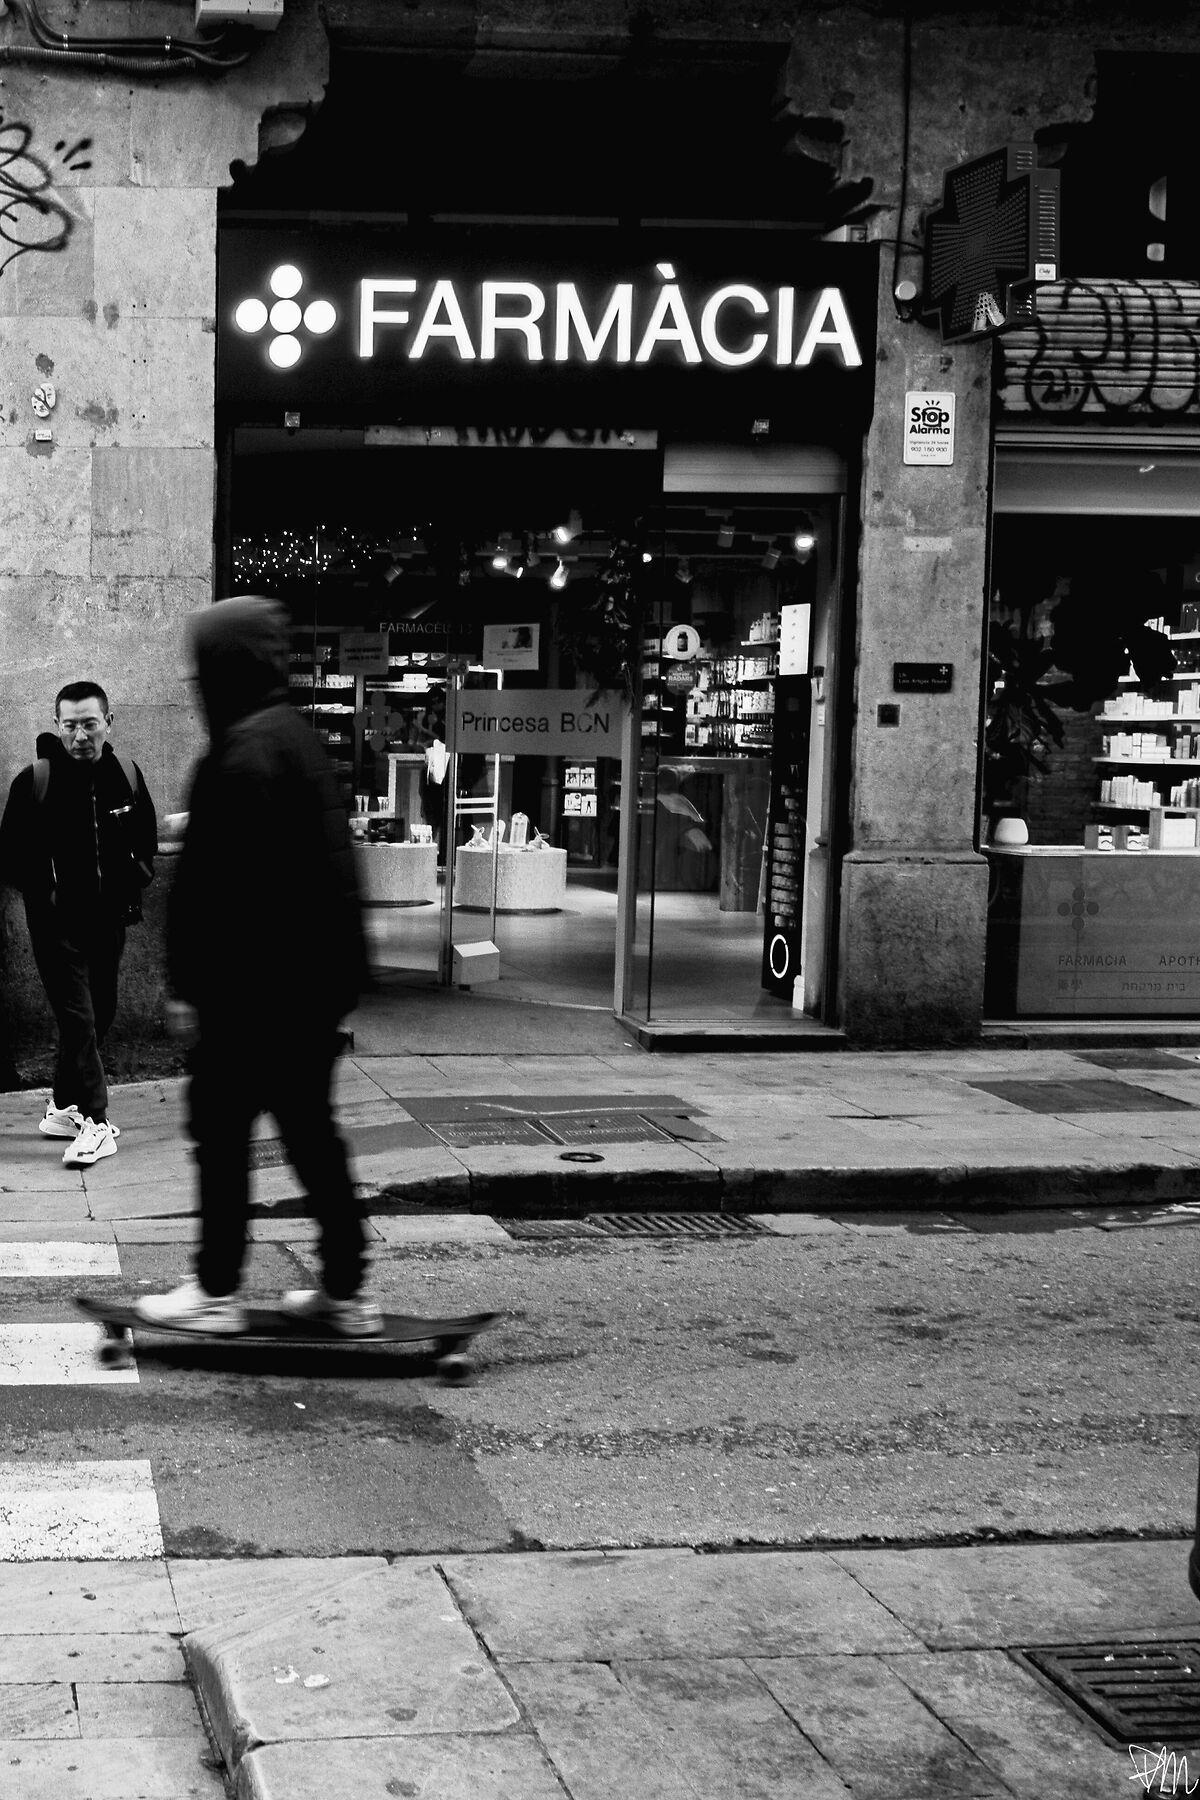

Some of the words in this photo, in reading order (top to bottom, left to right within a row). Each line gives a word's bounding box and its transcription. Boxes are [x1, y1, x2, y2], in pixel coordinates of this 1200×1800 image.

[359, 263, 863, 367] FARMÀCIA
[911, 407, 950, 428] Stop
[909, 424, 951, 435] Alarma
[461, 711, 549, 734] Princesa
[560, 712, 610, 735] BCN
[1058, 954, 1127, 967] FARMACIA
